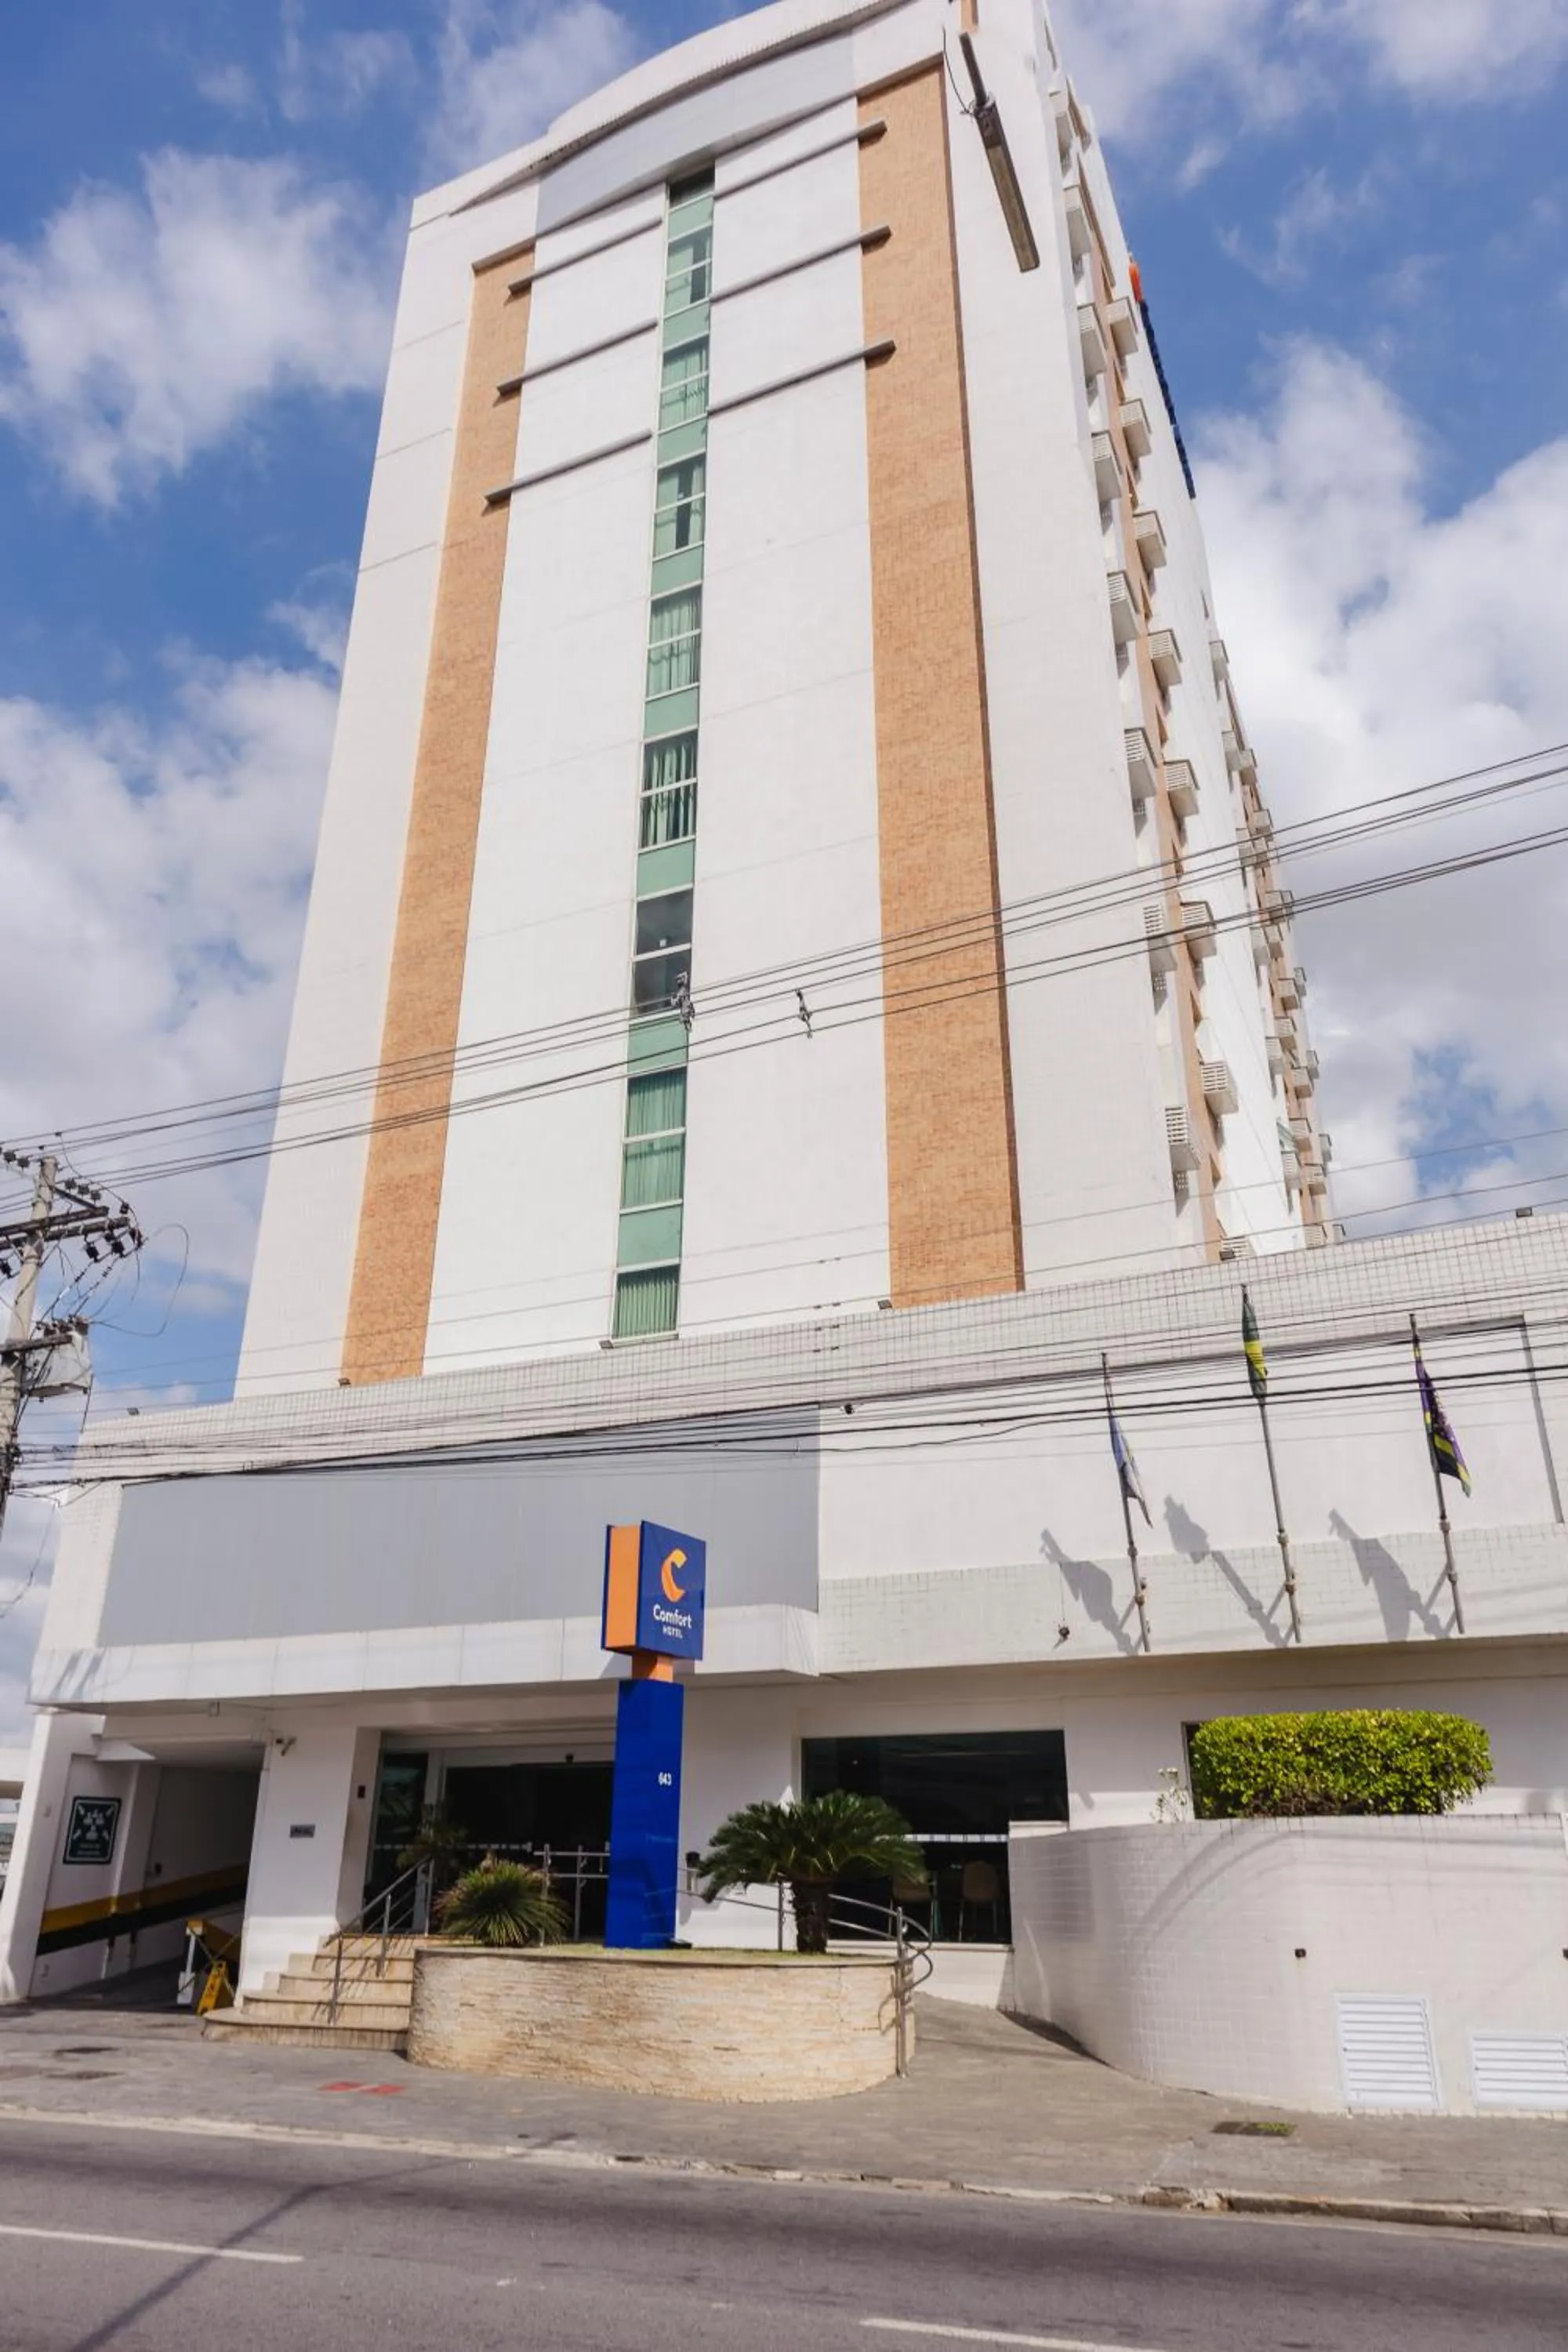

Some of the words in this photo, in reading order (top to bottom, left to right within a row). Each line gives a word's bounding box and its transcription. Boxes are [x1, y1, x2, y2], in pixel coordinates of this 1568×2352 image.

[653, 1603, 691, 1629] Comfort
[662, 1625, 684, 1639] HOTEL
[658, 1771, 672, 1786] 643
